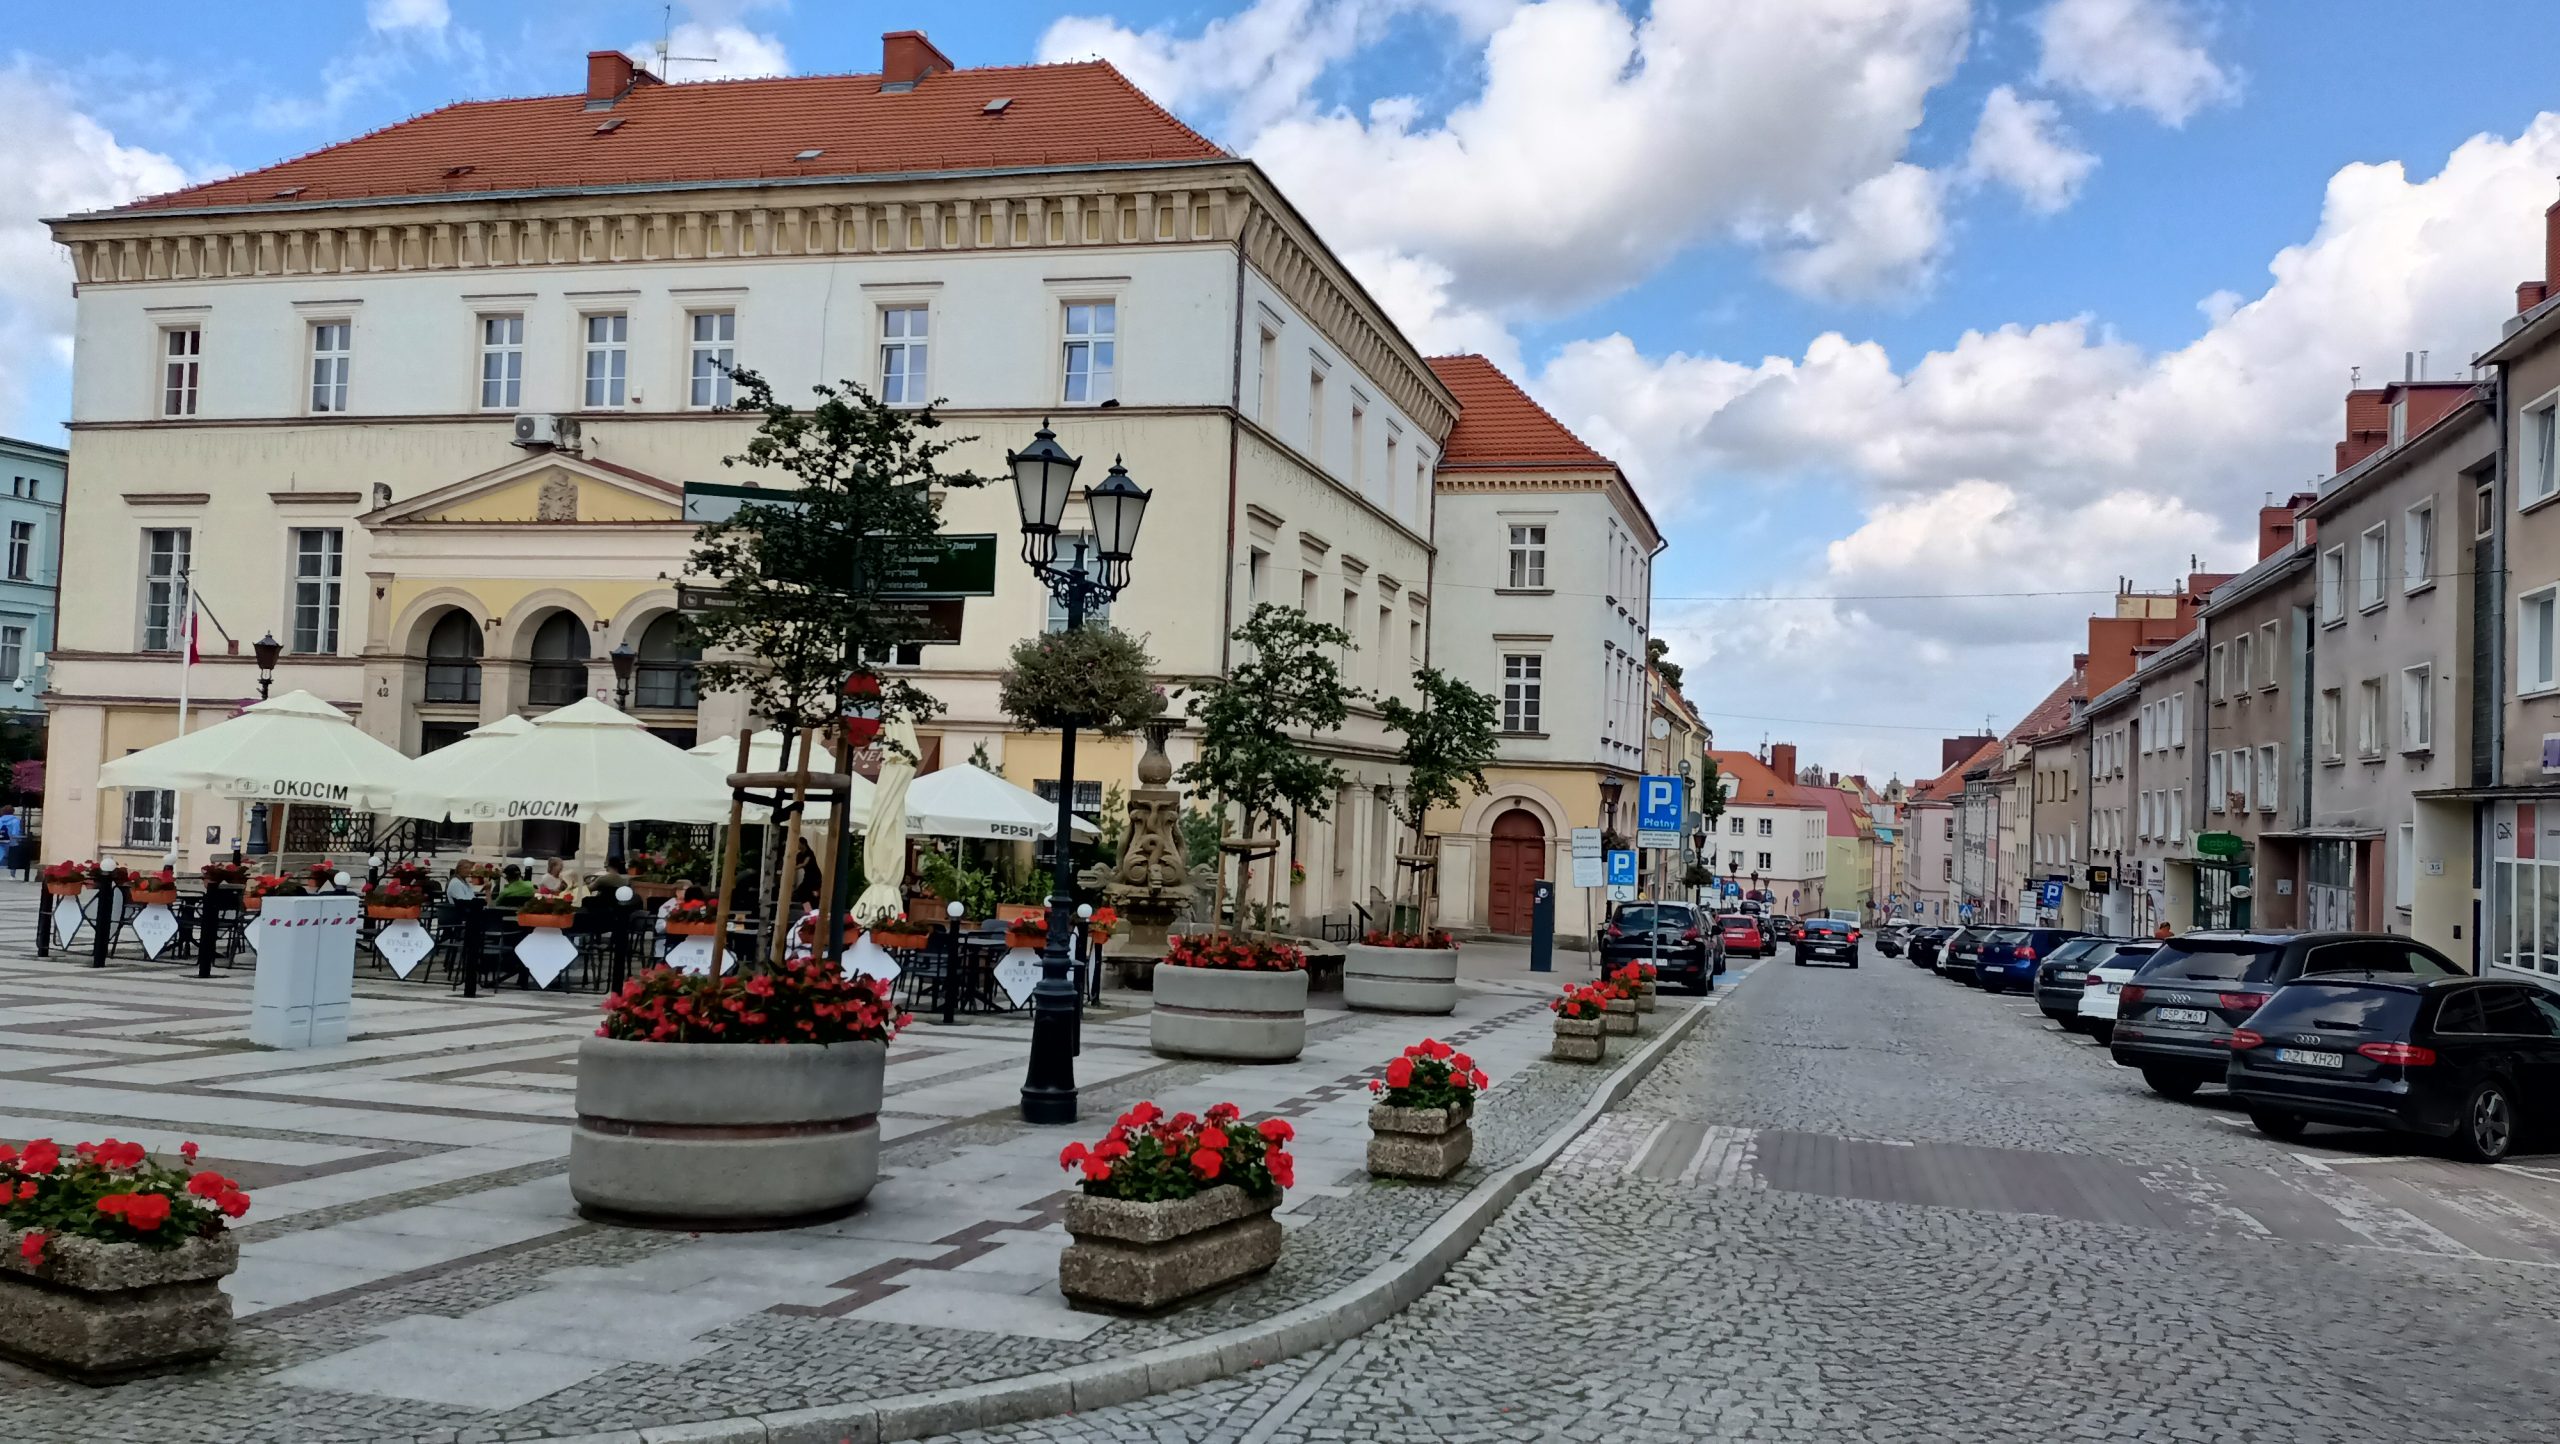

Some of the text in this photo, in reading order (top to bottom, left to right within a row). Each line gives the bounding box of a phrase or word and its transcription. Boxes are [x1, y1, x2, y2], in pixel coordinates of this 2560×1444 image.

[377, 687, 389, 697] 42
[273, 779, 349, 801] OKOCIM
[1648, 781, 1672, 814] P
[507, 800, 579, 818] OKOCIM
[990, 823, 1034, 837] PEPSI
[1644, 817, 1675, 830] Płatny
[1613, 853, 1630, 875] P
[1728, 883, 1736, 894] P
[2046, 884, 2060, 899] P
[2162, 1008, 2180, 1019] GSP
[2283, 1049, 2342, 1068] DZL XH20
